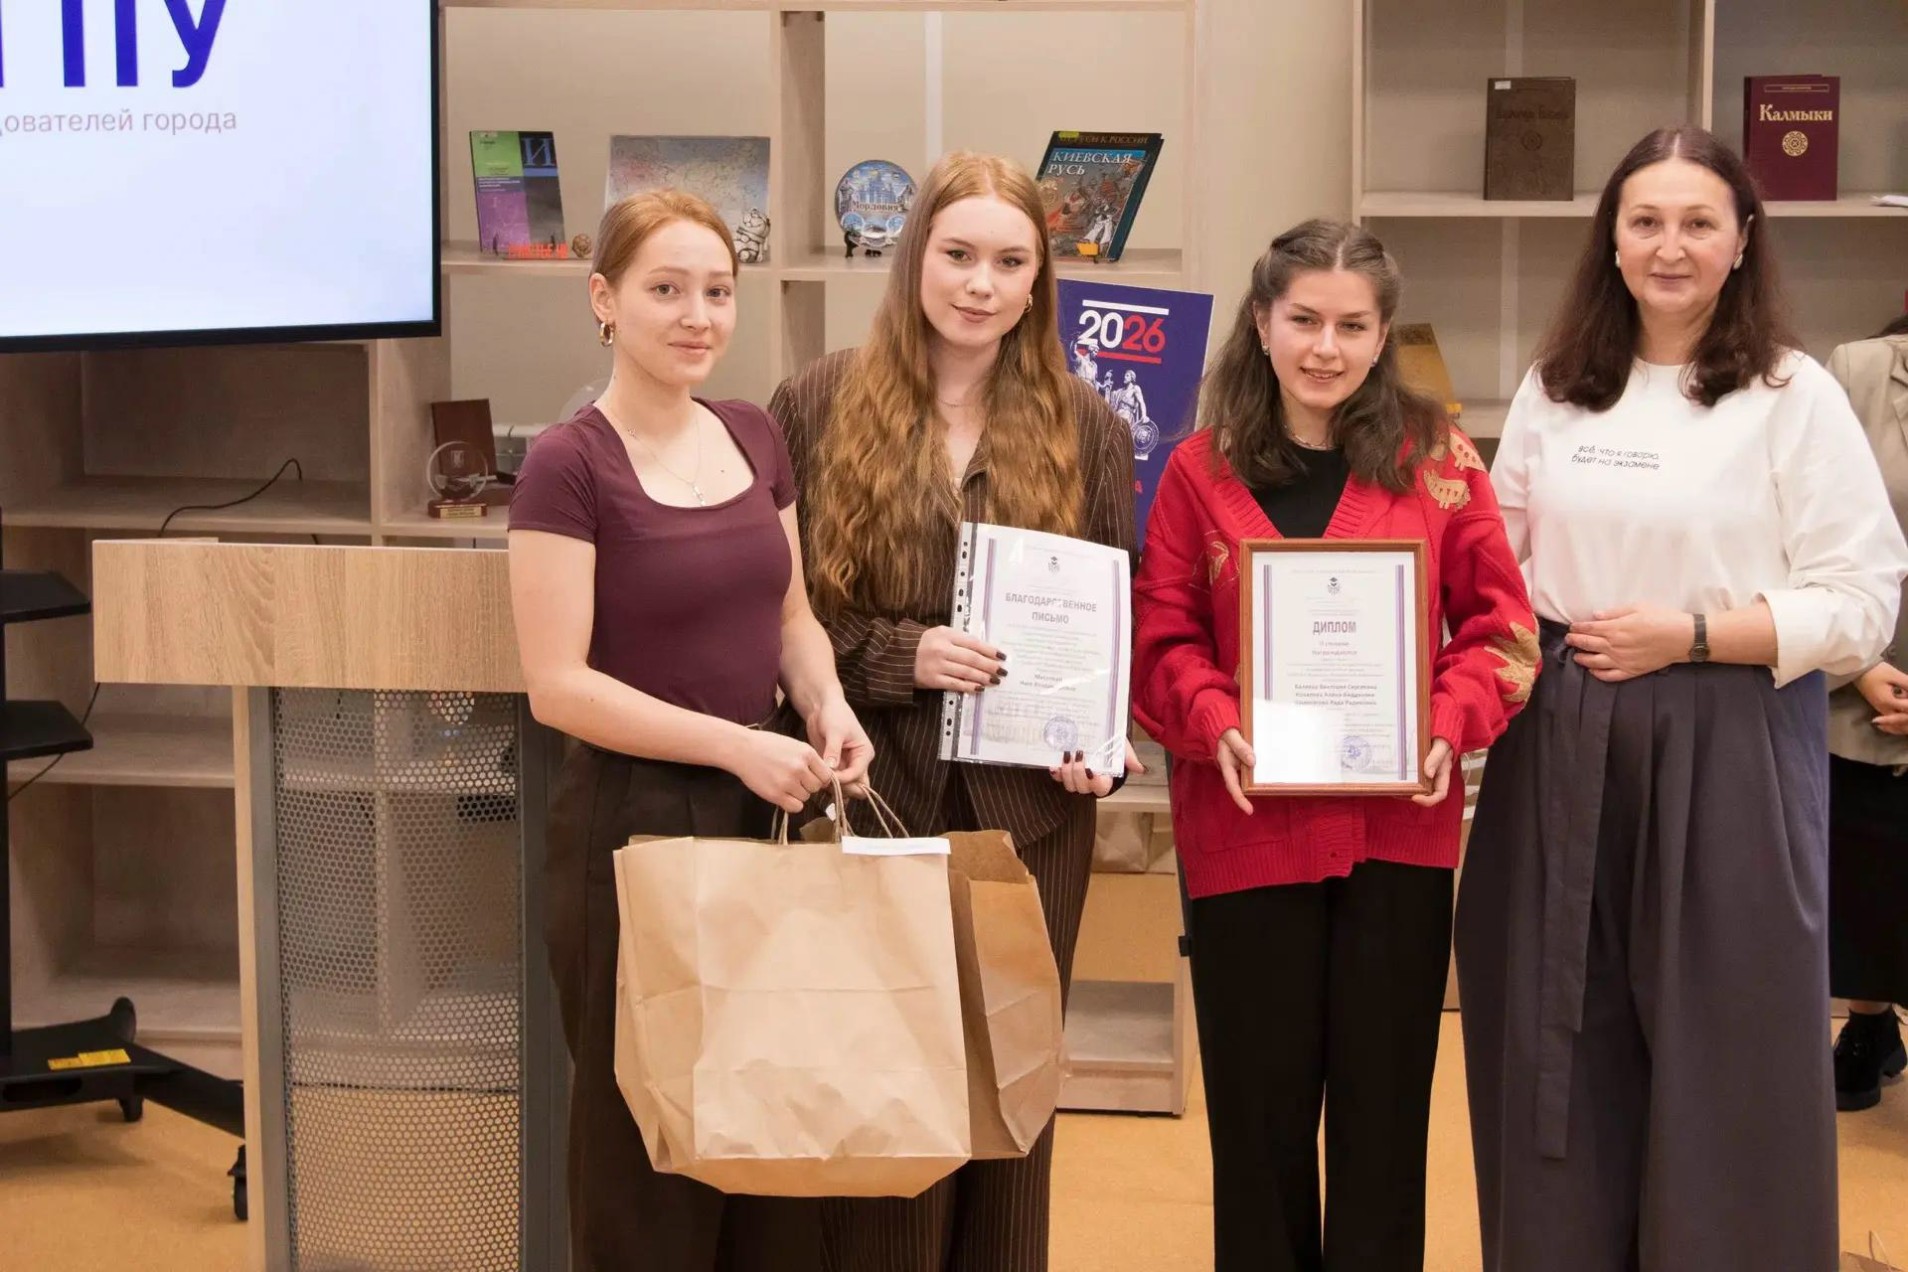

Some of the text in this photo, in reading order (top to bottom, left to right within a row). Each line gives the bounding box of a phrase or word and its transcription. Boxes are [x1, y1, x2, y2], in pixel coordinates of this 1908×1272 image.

[1760, 104, 1833, 121] Калмыки
[0, 109, 236, 135] ователей города
[1053, 151, 1132, 164] КИЕВСКАЯ
[1048, 164, 1085, 176] РУСЬ
[852, 201, 899, 212] Мордовия
[1077, 310, 1164, 353] 2026
[1600, 448, 1615, 457] что
[1624, 451, 1659, 460] говорю
[1571, 453, 1660, 470] будет на экзамене
[1032, 612, 1069, 624] ПИСЬМО
[1312, 621, 1357, 635] ДИПЛОМ
